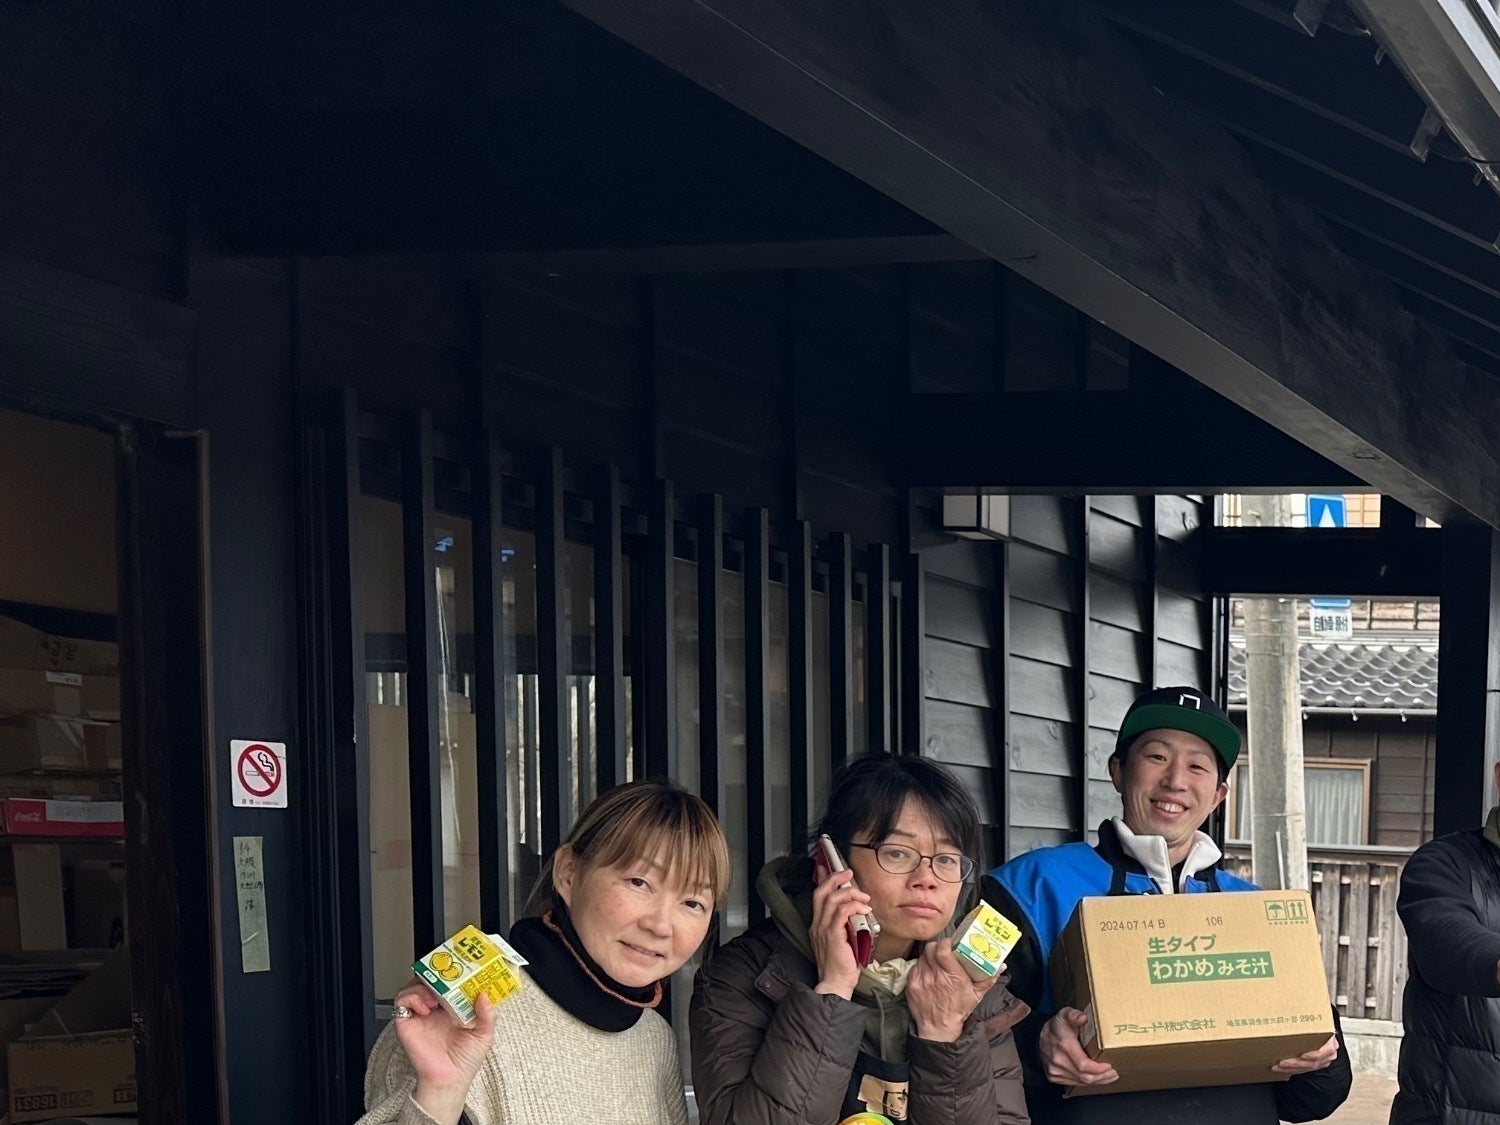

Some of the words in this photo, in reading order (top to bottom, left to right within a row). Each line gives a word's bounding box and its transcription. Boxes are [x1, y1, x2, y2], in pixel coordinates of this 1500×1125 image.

[1142, 920, 1154, 930] 14
[1158, 918, 1166, 929] B
[1147, 934, 1217, 955] 生タイプ
[1152, 957, 1270, 980] わかめみそ汁
[1114, 1018, 1217, 1036] アミュード株式会社
